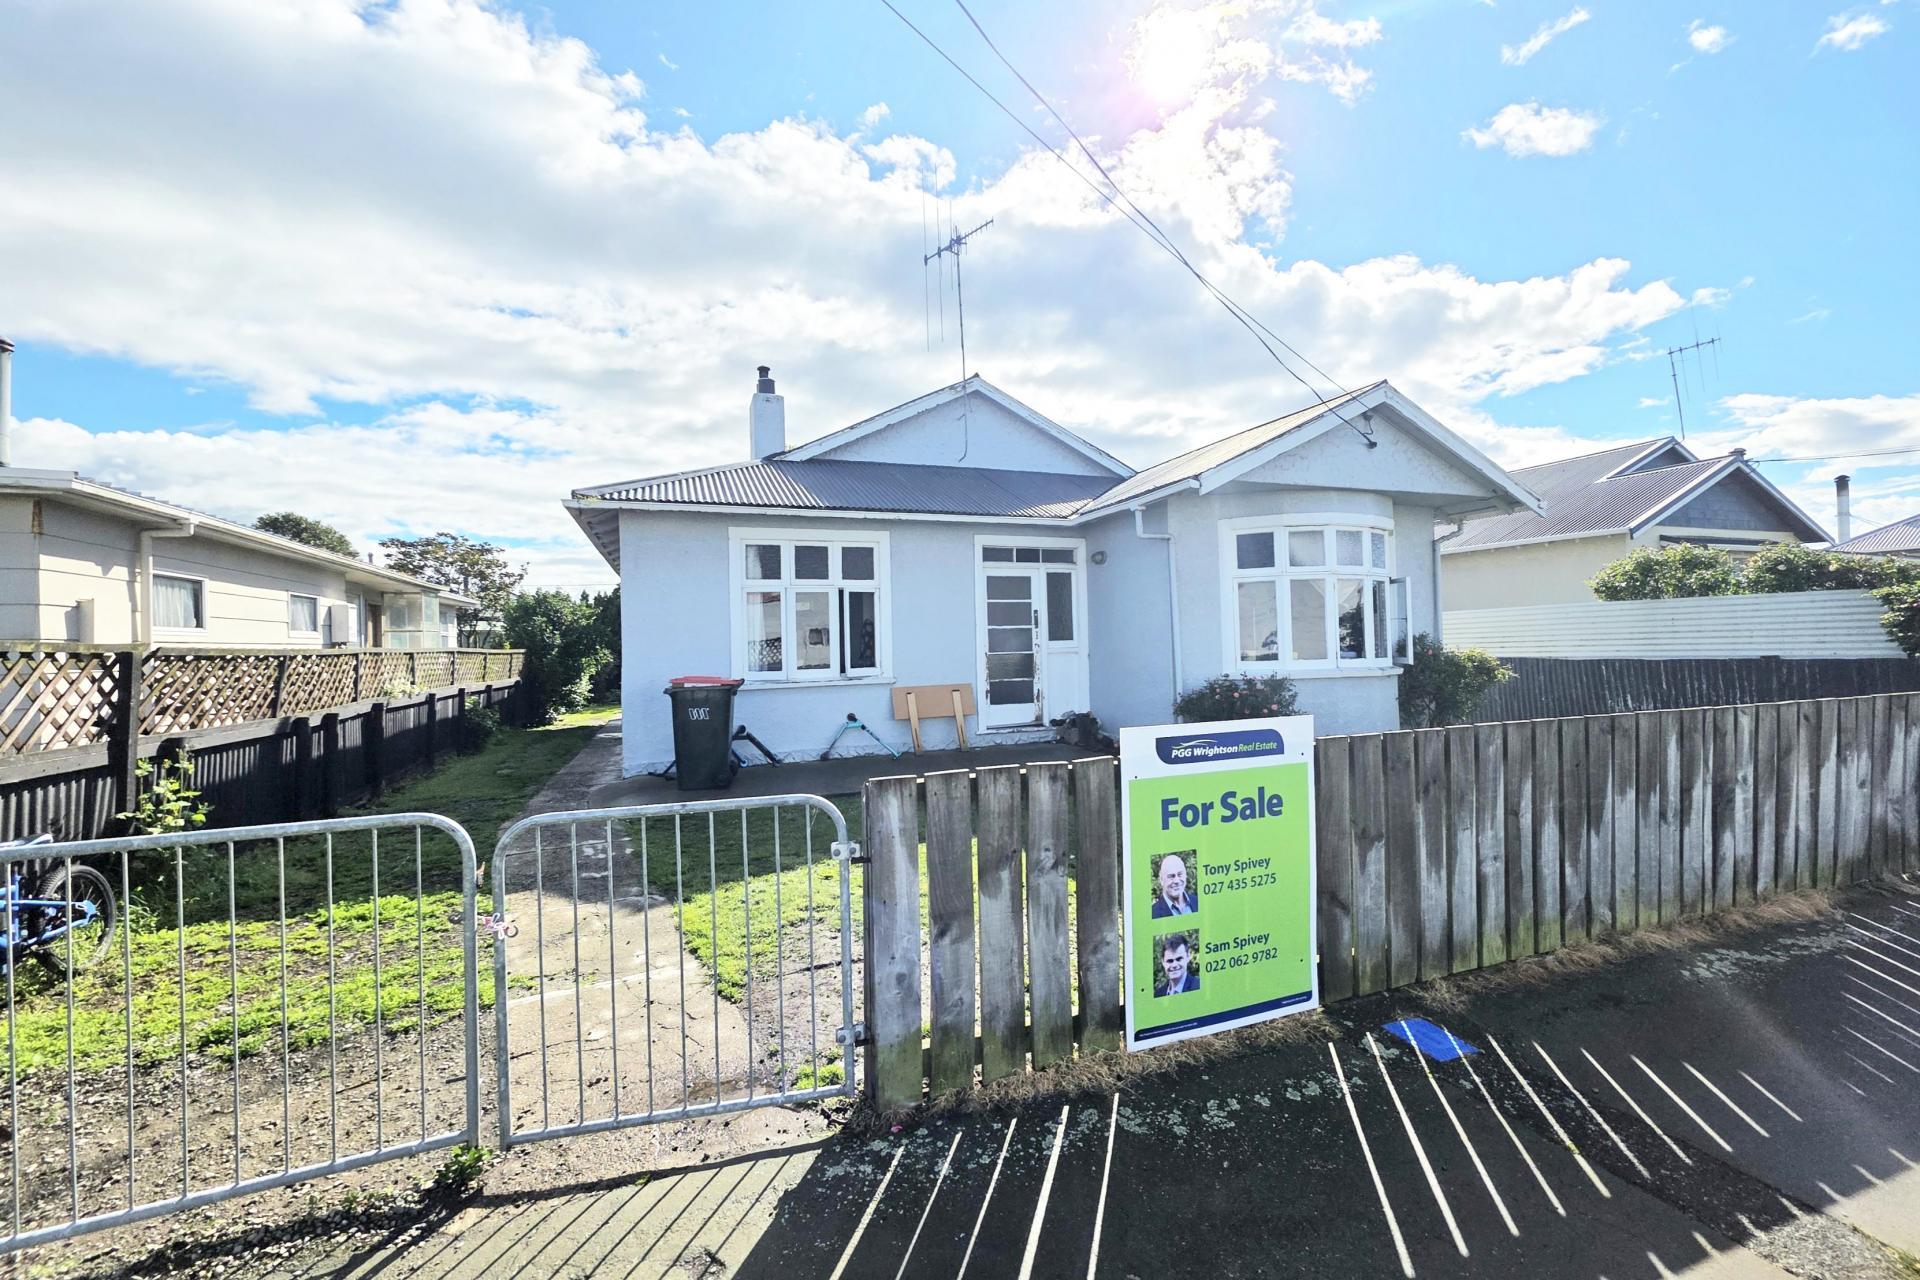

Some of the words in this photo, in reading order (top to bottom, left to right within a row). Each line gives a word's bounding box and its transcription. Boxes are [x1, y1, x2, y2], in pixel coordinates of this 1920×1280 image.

[1171, 749, 1192, 758] PGG
[1193, 745, 1238, 757] Wrightson
[1238, 743, 1255, 752] Real
[1255, 741, 1278, 750] Estate
[1161, 797, 1214, 830] For
[1220, 786, 1283, 823] Sale
[1203, 863, 1231, 876] Tony
[1234, 857, 1271, 873] Spivey
[1203, 881, 1224, 895] 027
[1227, 877, 1248, 891] 435
[1250, 873, 1277, 887] 5275
[1205, 942, 1230, 954] Sam
[1233, 933, 1270, 950] Spivey
[1205, 959, 1226, 973] 022
[1229, 954, 1249, 968] 062
[1252, 947, 1278, 963] 9782
